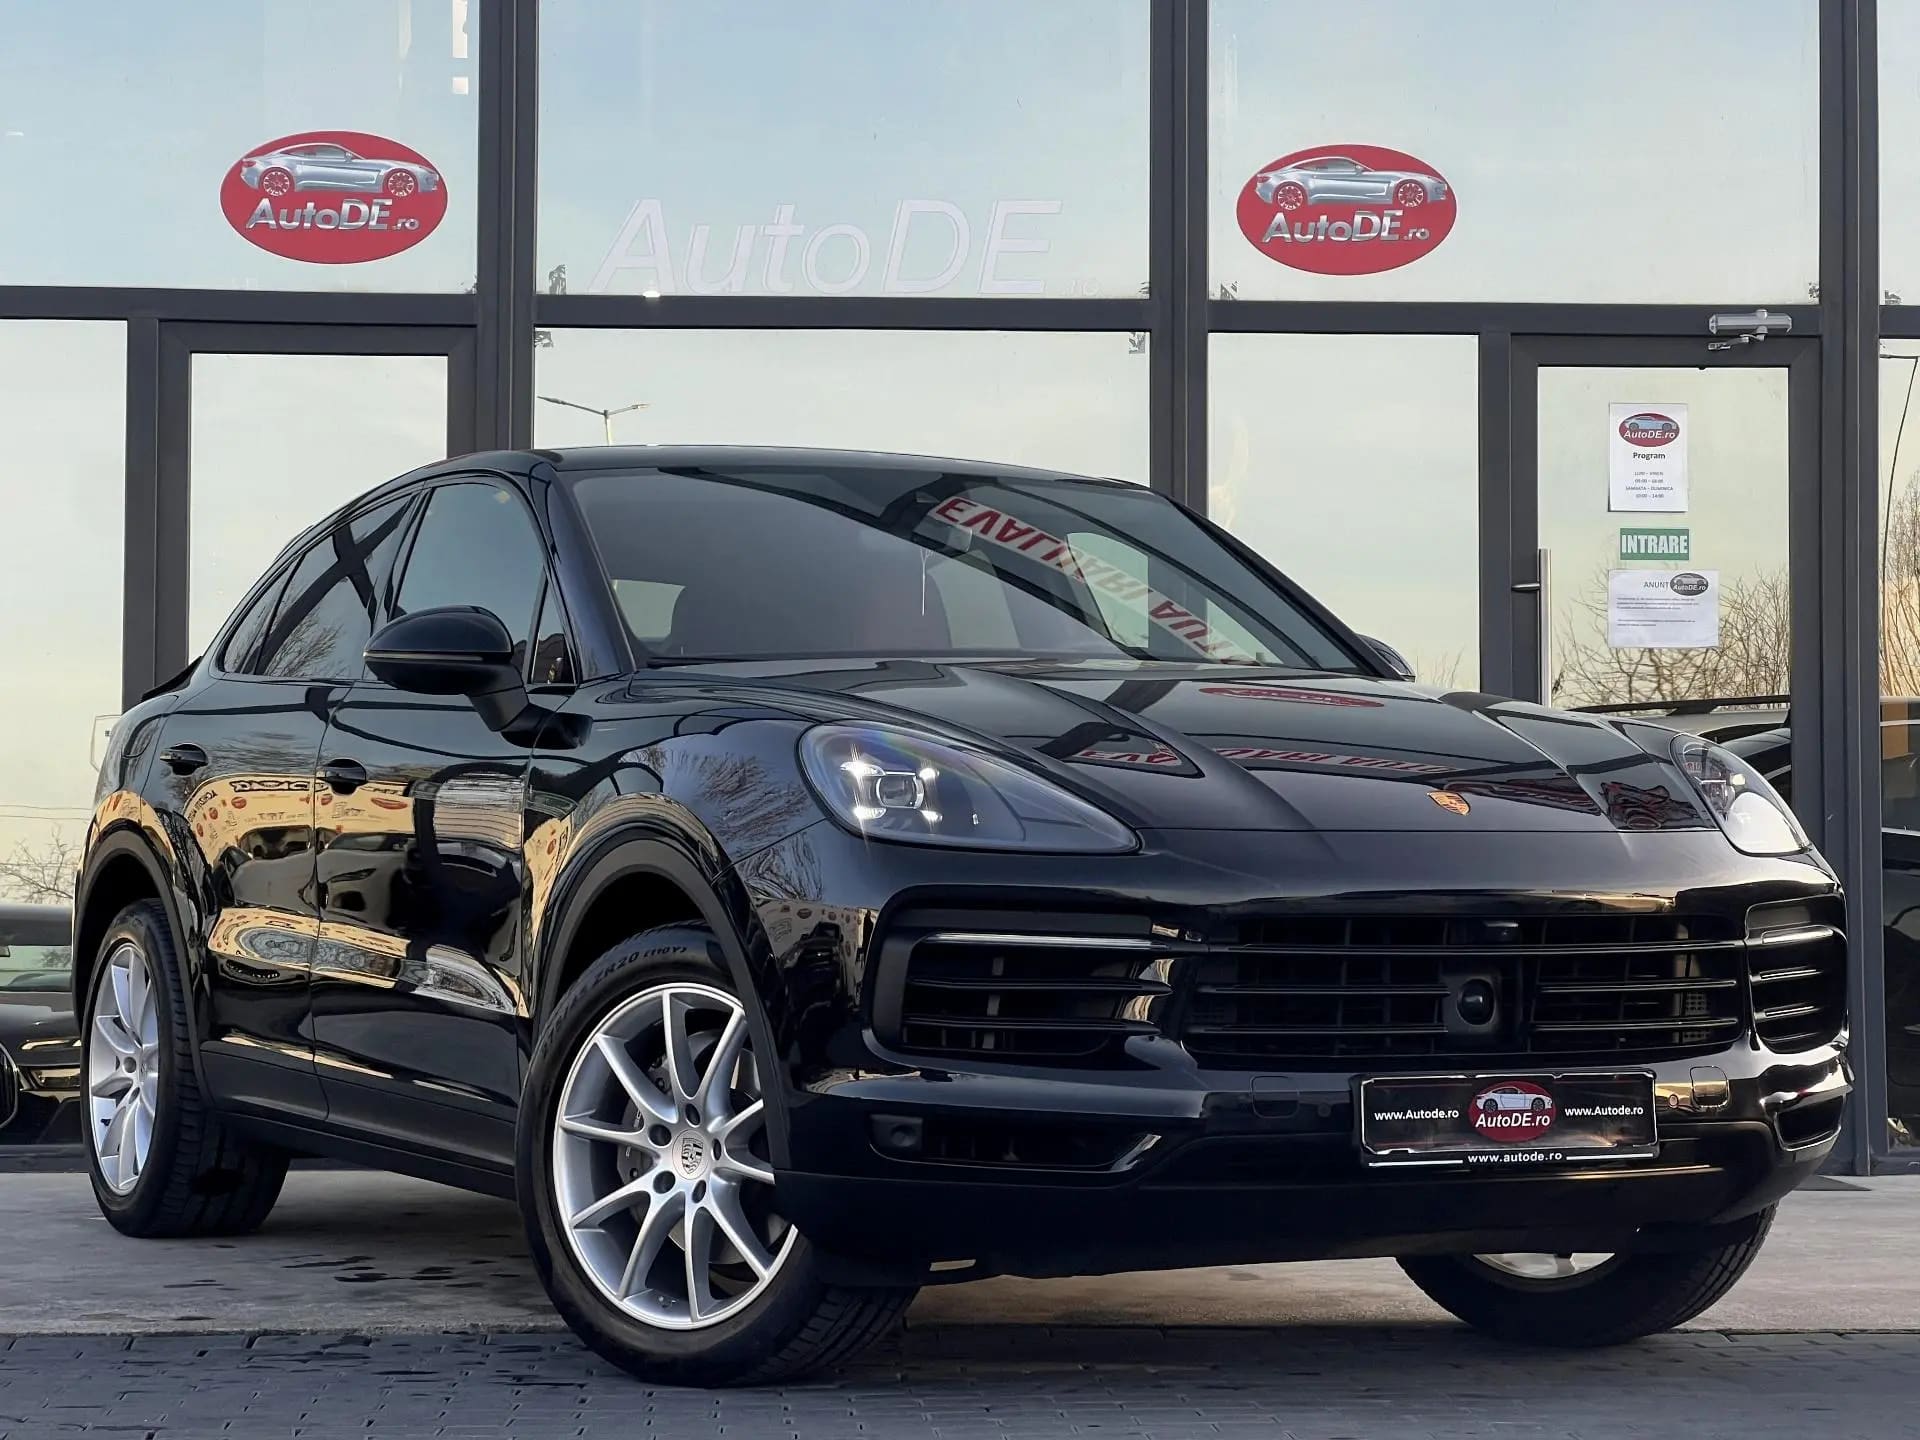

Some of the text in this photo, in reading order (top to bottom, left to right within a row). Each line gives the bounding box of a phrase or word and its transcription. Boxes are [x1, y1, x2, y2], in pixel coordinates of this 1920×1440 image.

[246, 197, 420, 231] AutoDE.ro
[1261, 209, 1430, 244] AutoDE.ro
[1623, 429, 1676, 439] AutoDE.ro
[1632, 451, 1666, 461] Program
[1621, 534, 1688, 554] INTRARE
[1374, 1108, 1459, 1121] www.Autode.ro
[1565, 1105, 1644, 1117] www.Autode.ro
[1475, 1112, 1551, 1129] AutoDE.ro
[1468, 1151, 1562, 1163] www.autode.ro
